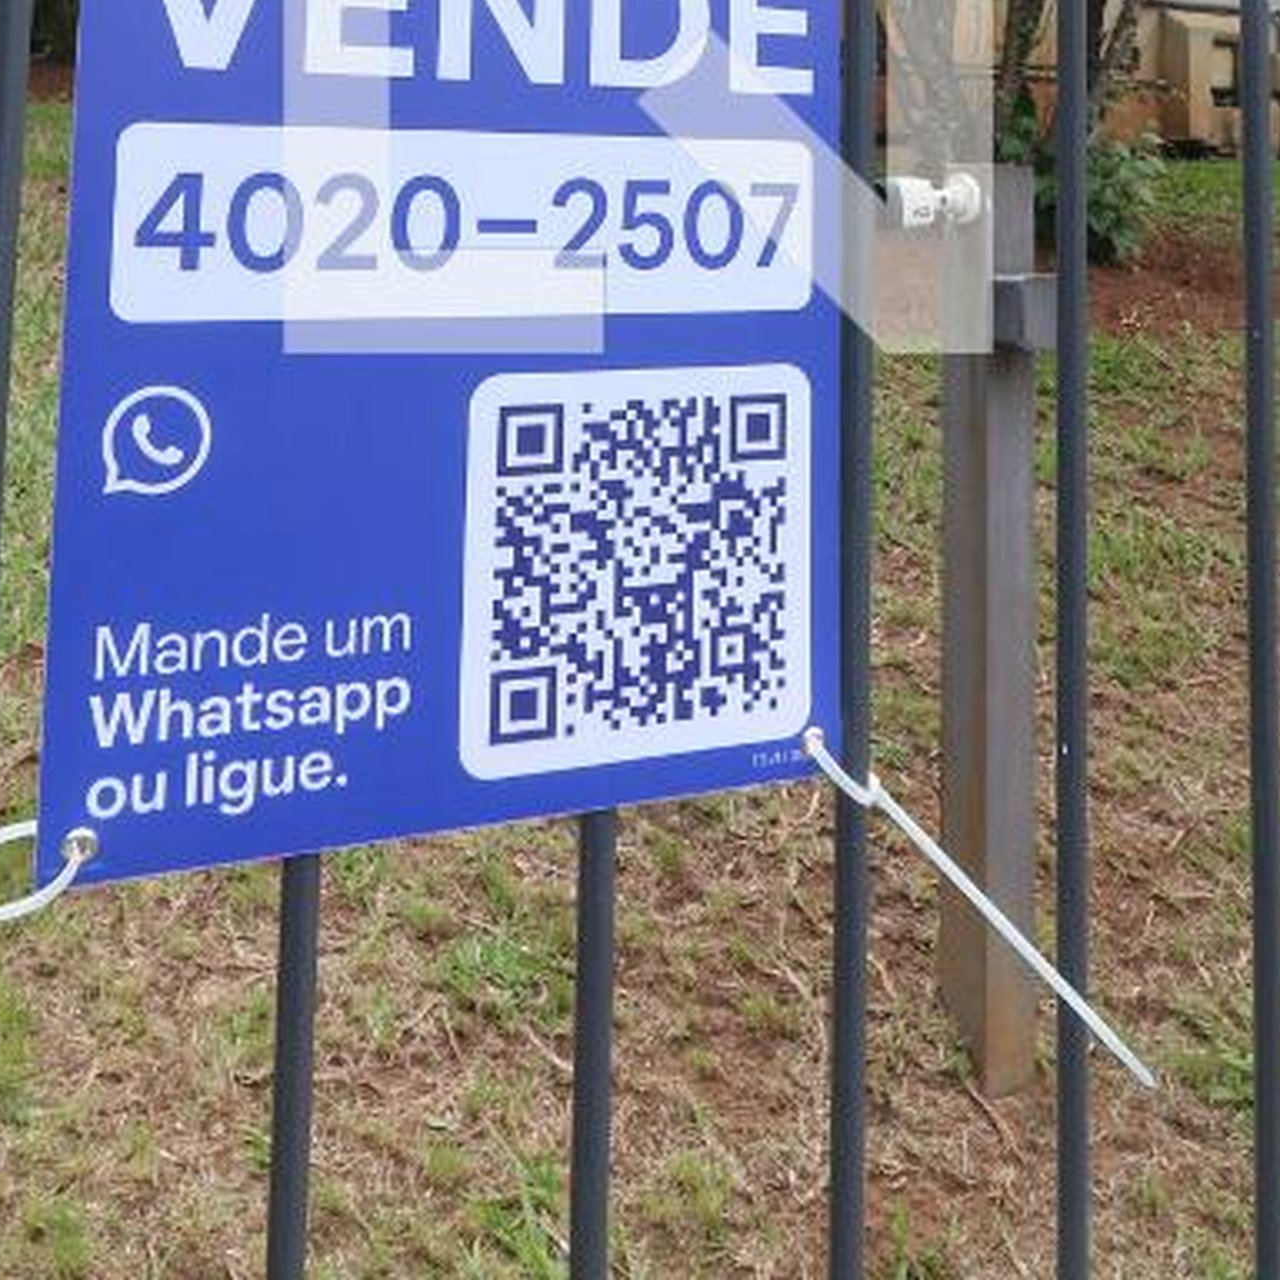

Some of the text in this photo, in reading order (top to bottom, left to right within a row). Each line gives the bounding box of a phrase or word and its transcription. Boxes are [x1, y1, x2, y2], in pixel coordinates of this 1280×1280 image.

[133, 172, 800, 272] 4020-2507
[94, 612, 412, 680] Mande um
[88, 676, 412, 748] Whatsapp
[86, 750, 348, 819] ou ligue.
